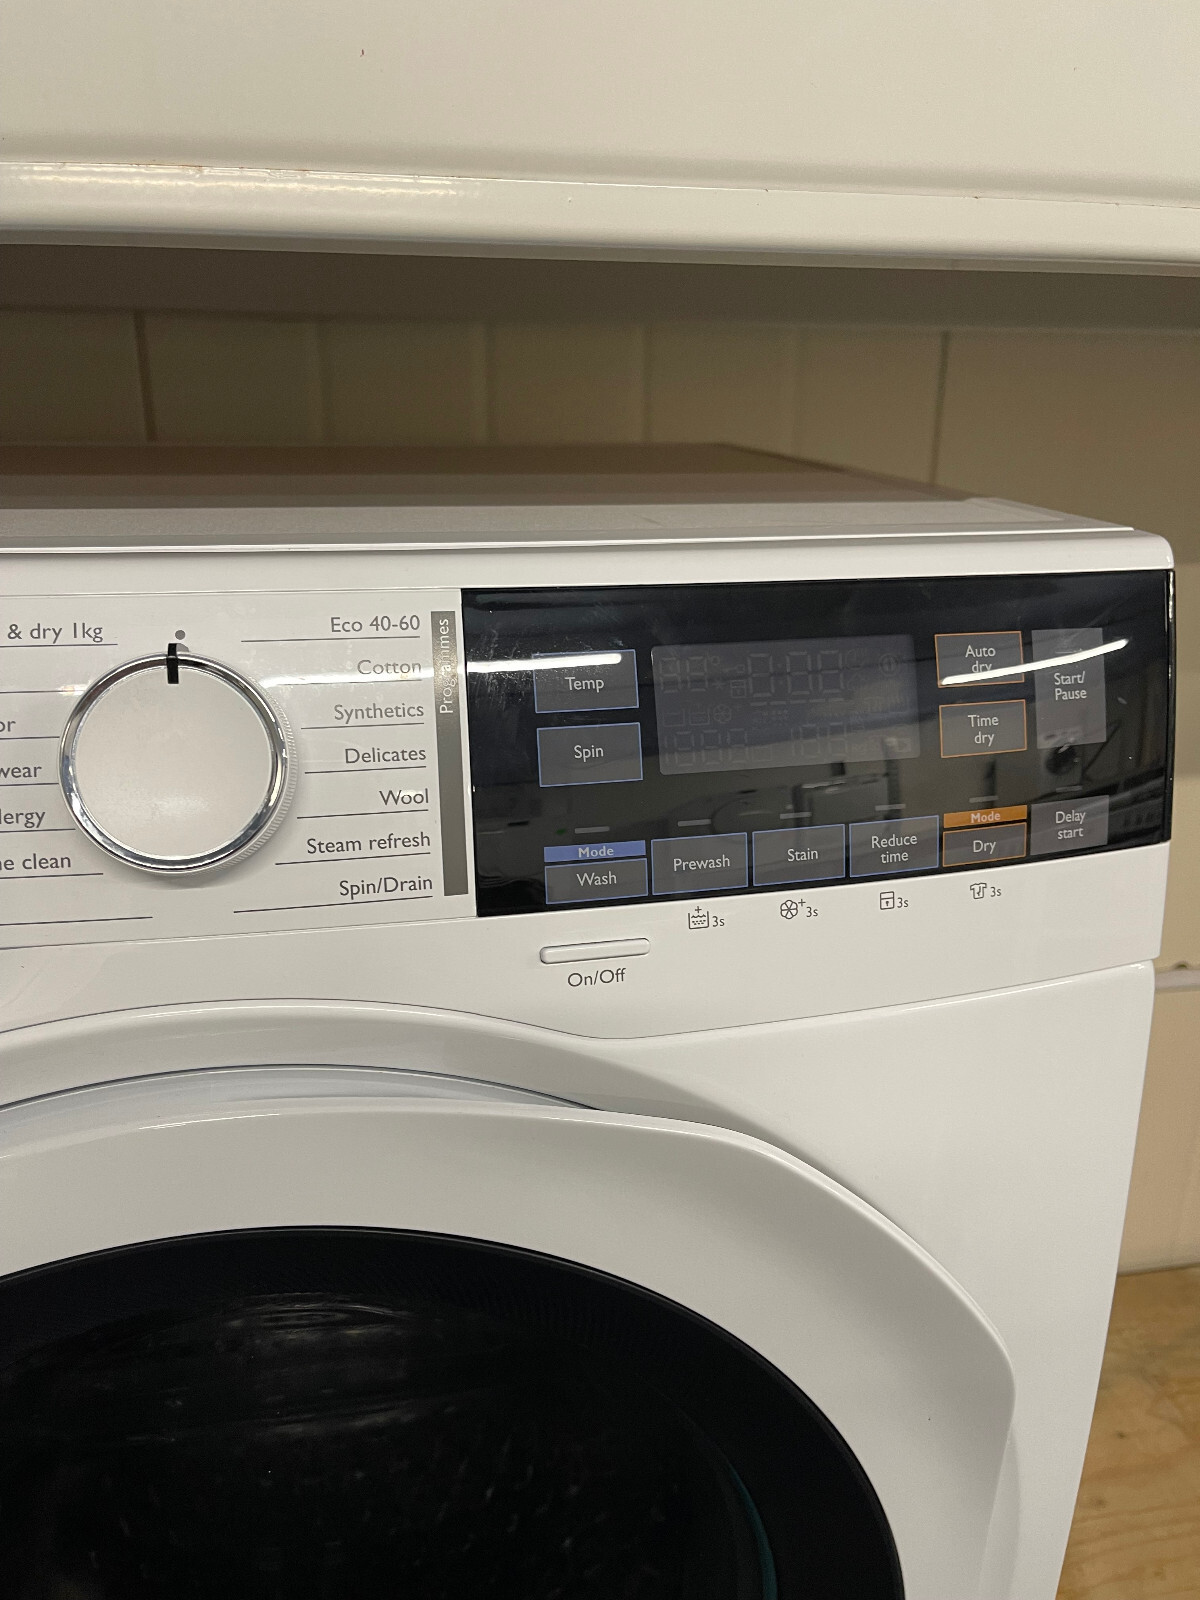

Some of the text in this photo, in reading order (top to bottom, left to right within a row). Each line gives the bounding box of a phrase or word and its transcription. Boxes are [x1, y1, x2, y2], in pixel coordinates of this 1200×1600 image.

[330, 614, 420, 632] Eco 40-60
[7, 622, 103, 644] & dry 1kg
[965, 645, 996, 658] Auto
[357, 659, 421, 675] Cotton
[439, 618, 457, 714] Programmes
[565, 676, 605, 693] Temp
[1053, 671, 1086, 685] Start/
[1054, 687, 1087, 700] Pause
[334, 703, 424, 724] Synthetics
[967, 714, 999, 728] Time
[974, 731, 995, 747] dry
[345, 747, 426, 764] Delicates
[574, 745, 604, 762] Spin
[379, 788, 429, 806] Wool
[971, 811, 1001, 824] Mode
[1055, 810, 1086, 824] Delay
[871, 834, 918, 848] Reduce
[1057, 827, 1084, 840] start
[306, 831, 430, 854] Steam refresh
[973, 839, 996, 854] Dry
[578, 845, 614, 858] Mode
[787, 848, 818, 862] Stain
[881, 851, 909, 864] time
[22, 853, 71, 870] clean
[673, 854, 731, 871] Prewash
[576, 871, 617, 886] Wash
[339, 875, 433, 900] Spin/Drain
[990, 886, 1002, 897] 3s
[896, 897, 909, 909] 3s
[806, 906, 819, 918] 3s
[712, 915, 725, 928] 3s
[567, 968, 626, 987] On/Off
